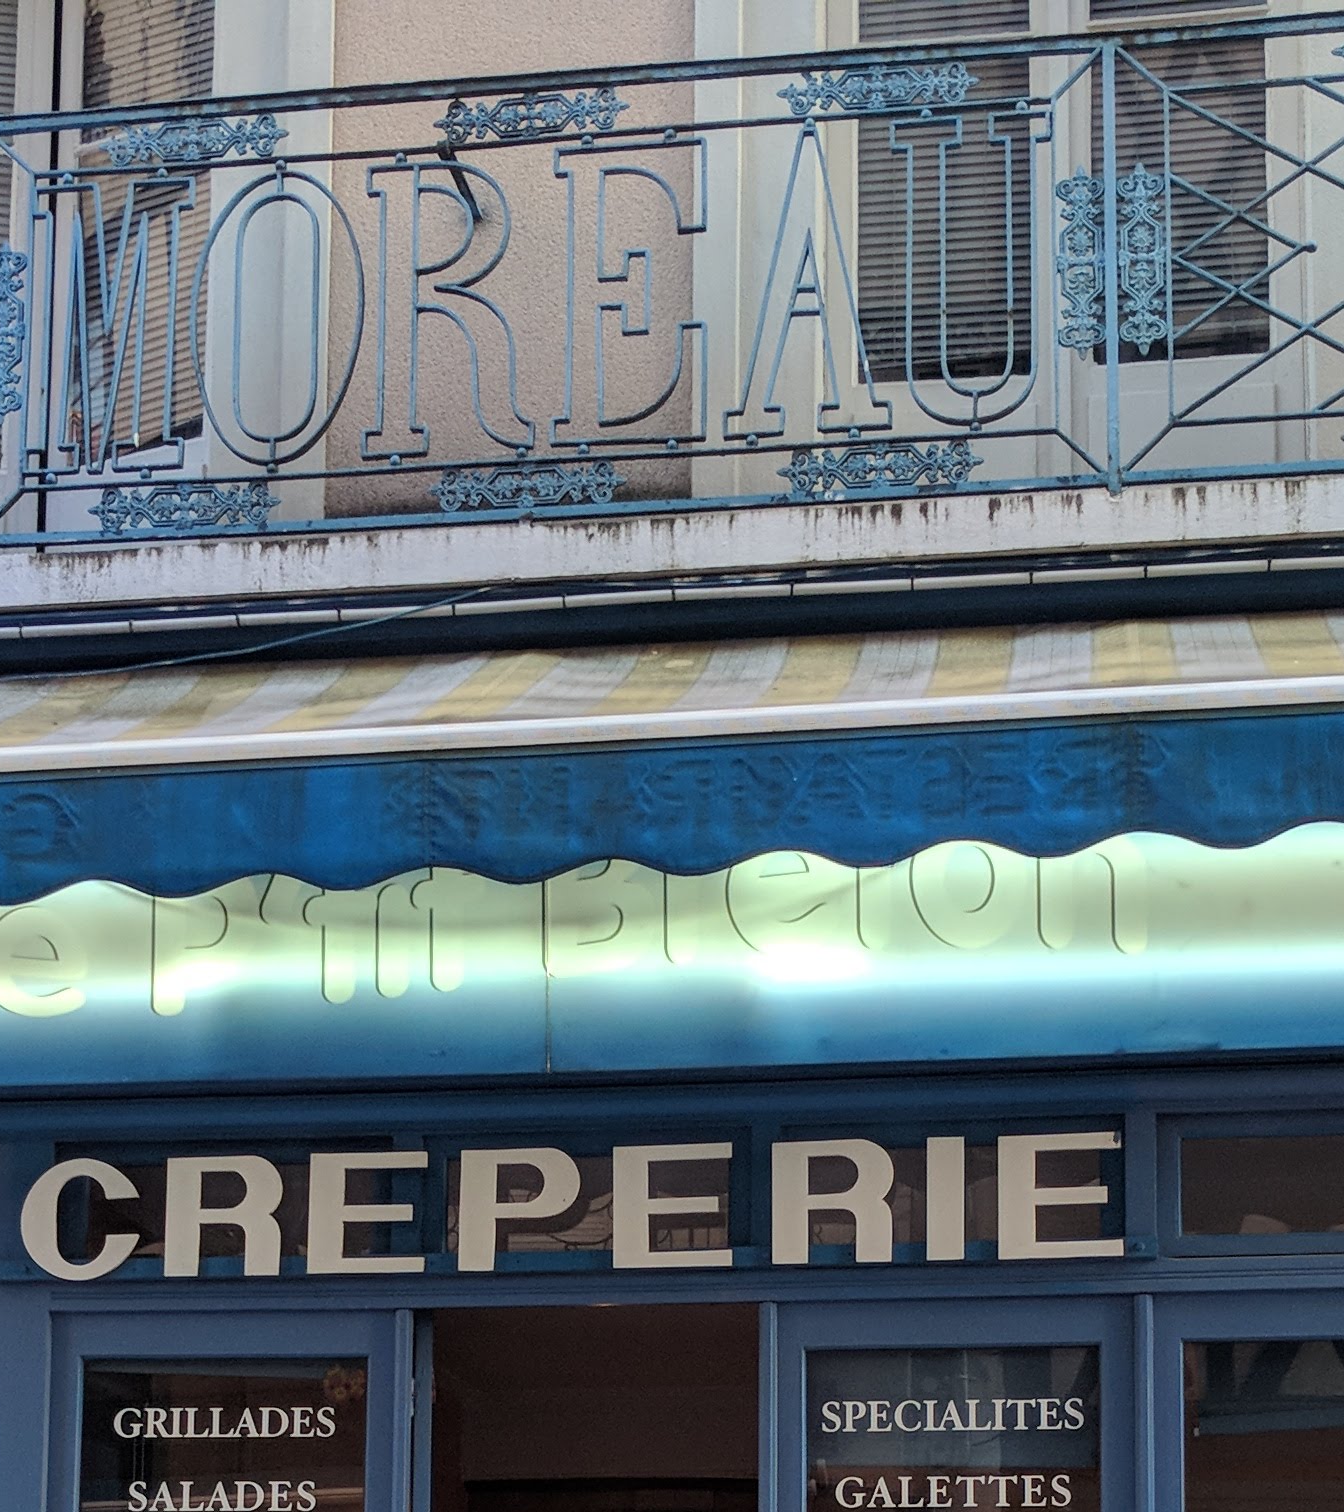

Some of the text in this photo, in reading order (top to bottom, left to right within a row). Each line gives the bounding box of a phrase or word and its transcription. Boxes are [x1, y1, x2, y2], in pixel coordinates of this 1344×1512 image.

[22, 110, 1052, 474] MOREAU
[20, 1131, 1125, 1280] CREPERIE
[113, 1406, 336, 1440] GRILLADES
[821, 1397, 1084, 1434] SPECIALITES
[128, 1480, 317, 1512] SALADES
[835, 1474, 1072, 1510] GALETTES
